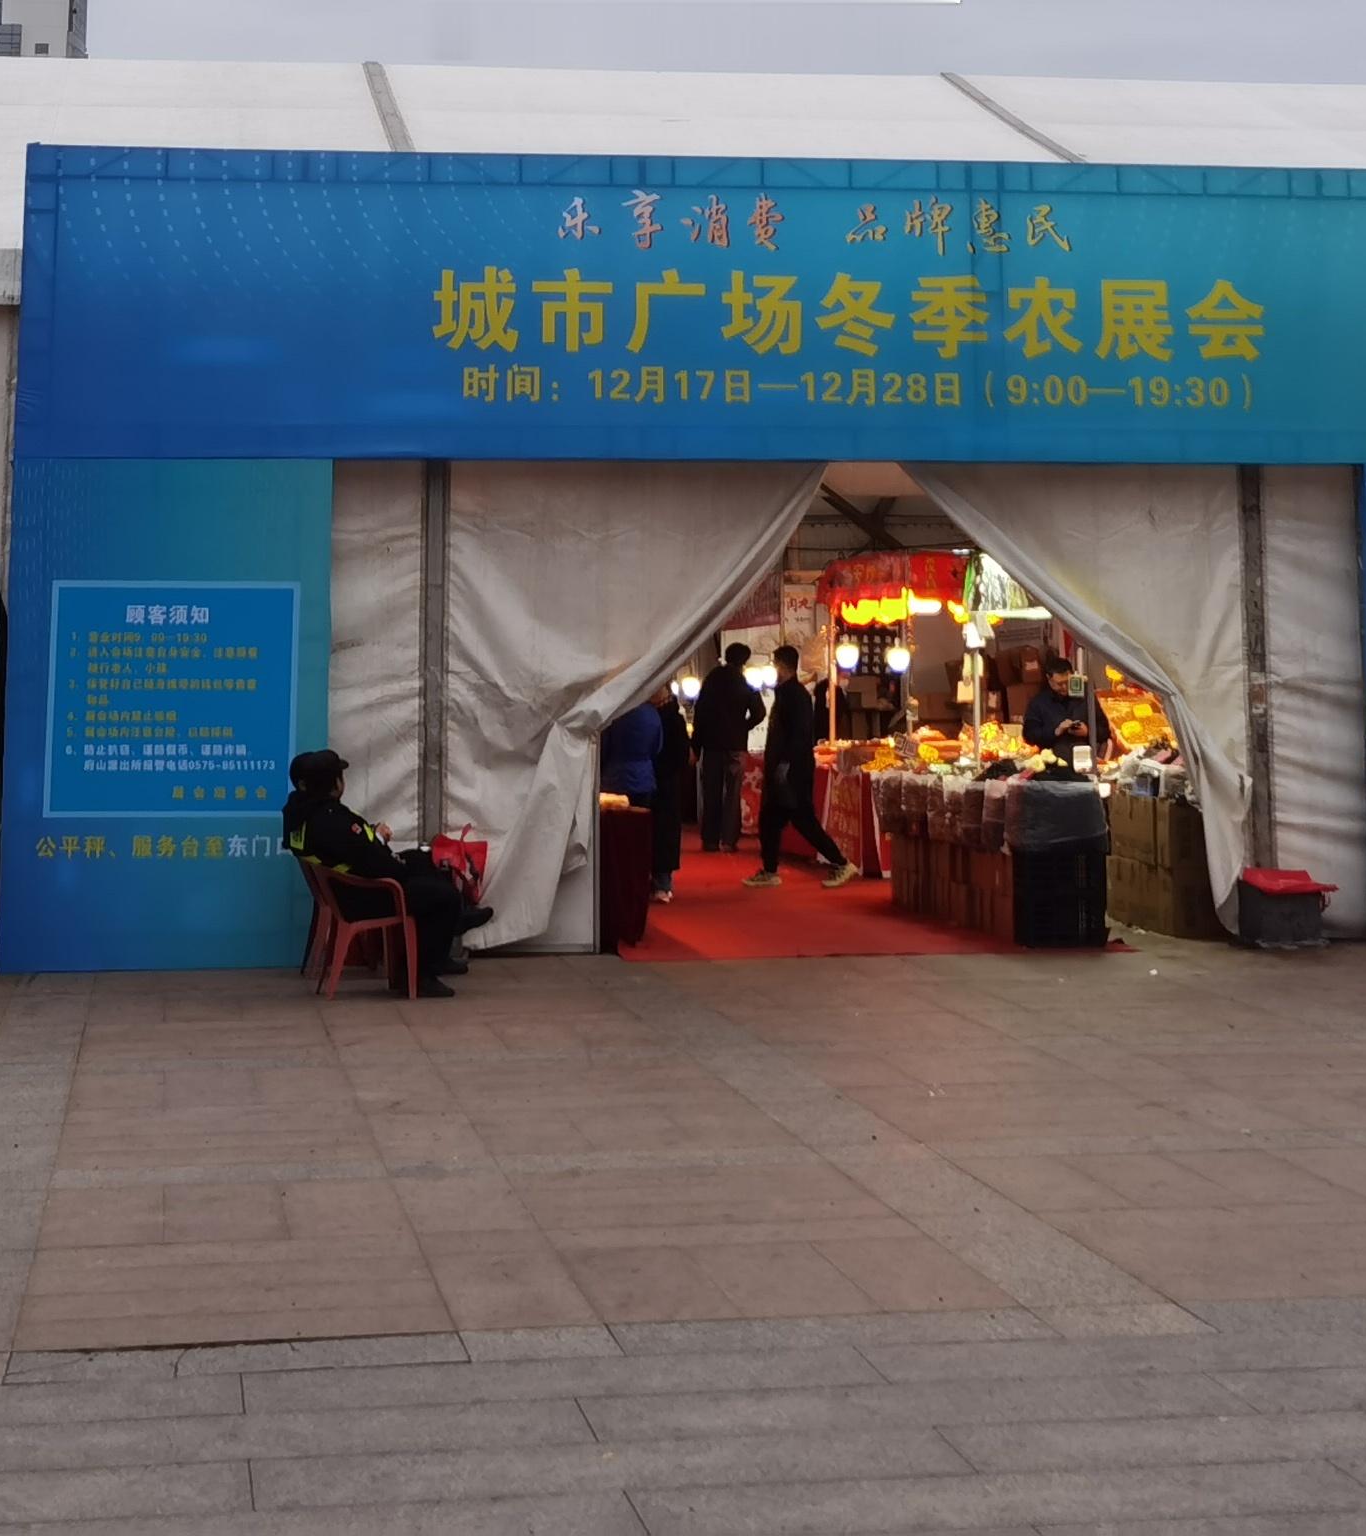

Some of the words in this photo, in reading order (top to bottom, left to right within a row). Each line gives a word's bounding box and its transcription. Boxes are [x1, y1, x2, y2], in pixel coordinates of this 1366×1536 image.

[558, 190, 784, 251] 乐享消费
[846, 194, 1072, 256] 品牌惠民
[432, 265, 1266, 361] 城市广场冬季农展会
[125, 604, 211, 625] 顾客须知
